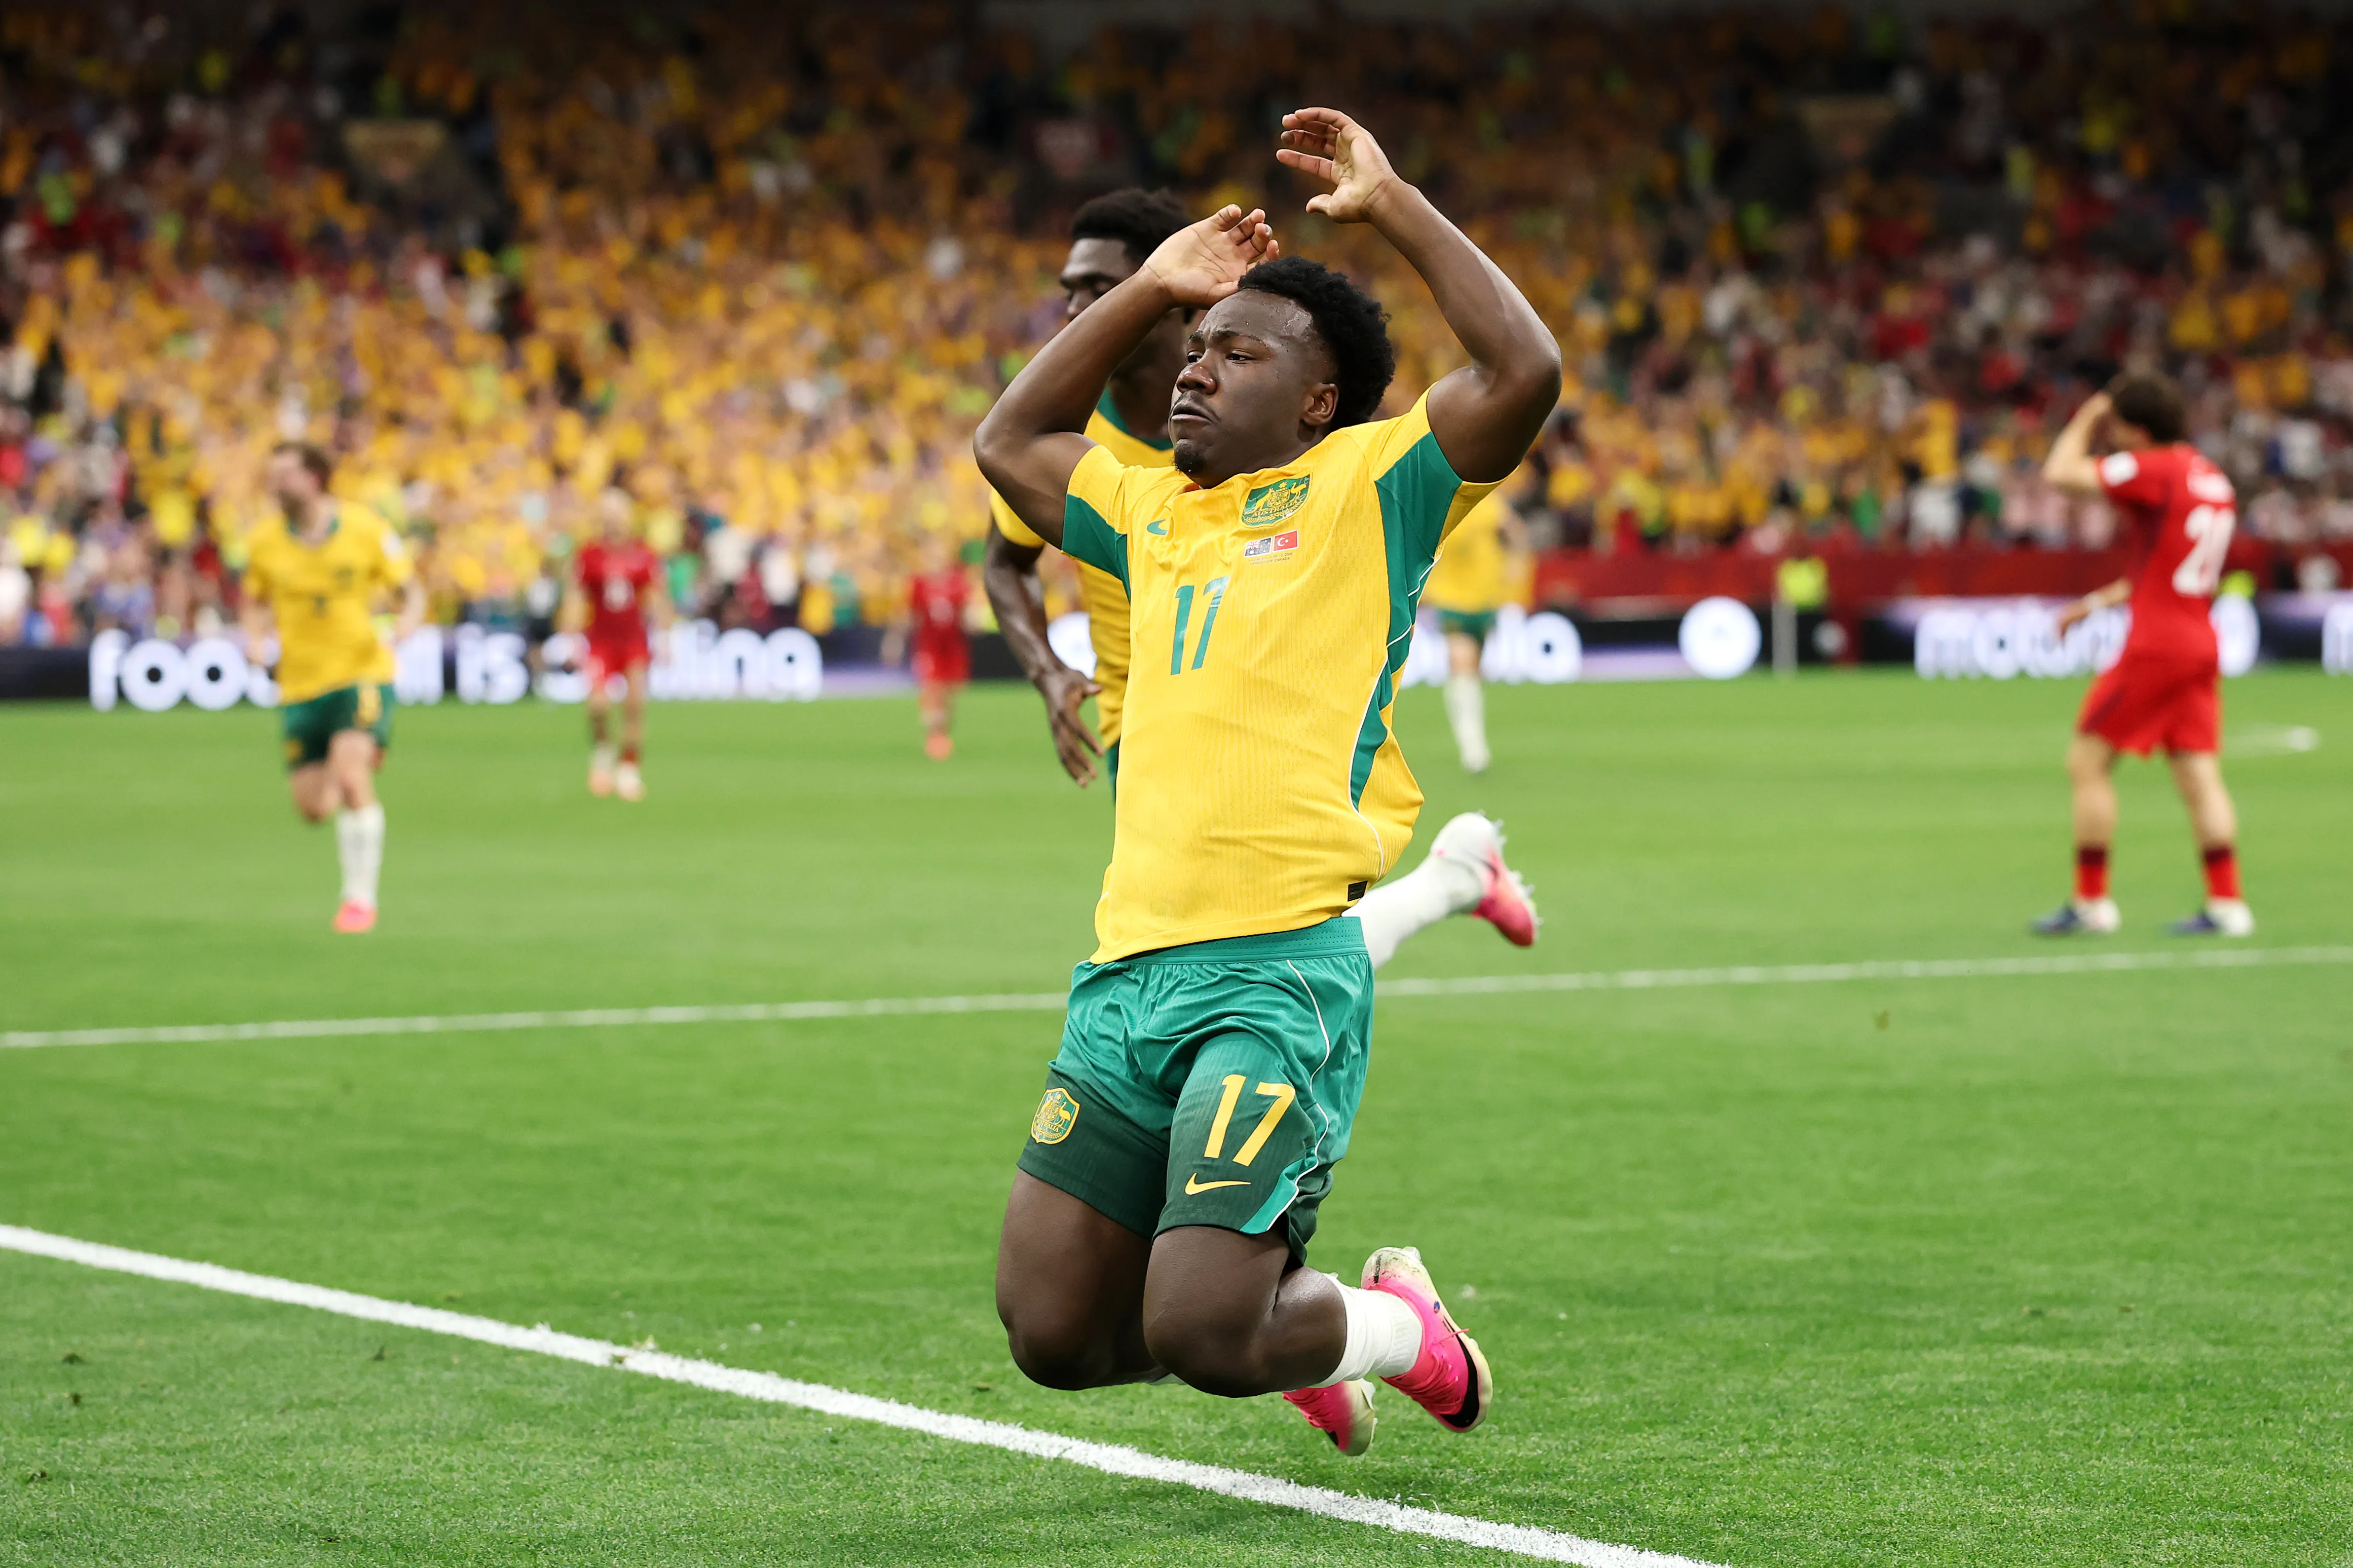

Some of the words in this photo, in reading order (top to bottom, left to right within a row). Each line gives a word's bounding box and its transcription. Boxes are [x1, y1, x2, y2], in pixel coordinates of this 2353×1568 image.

[1252, 500, 1297, 517] AUSTRALIA
[1171, 576, 1230, 675] 17
[1204, 1074, 1296, 1167] 17
